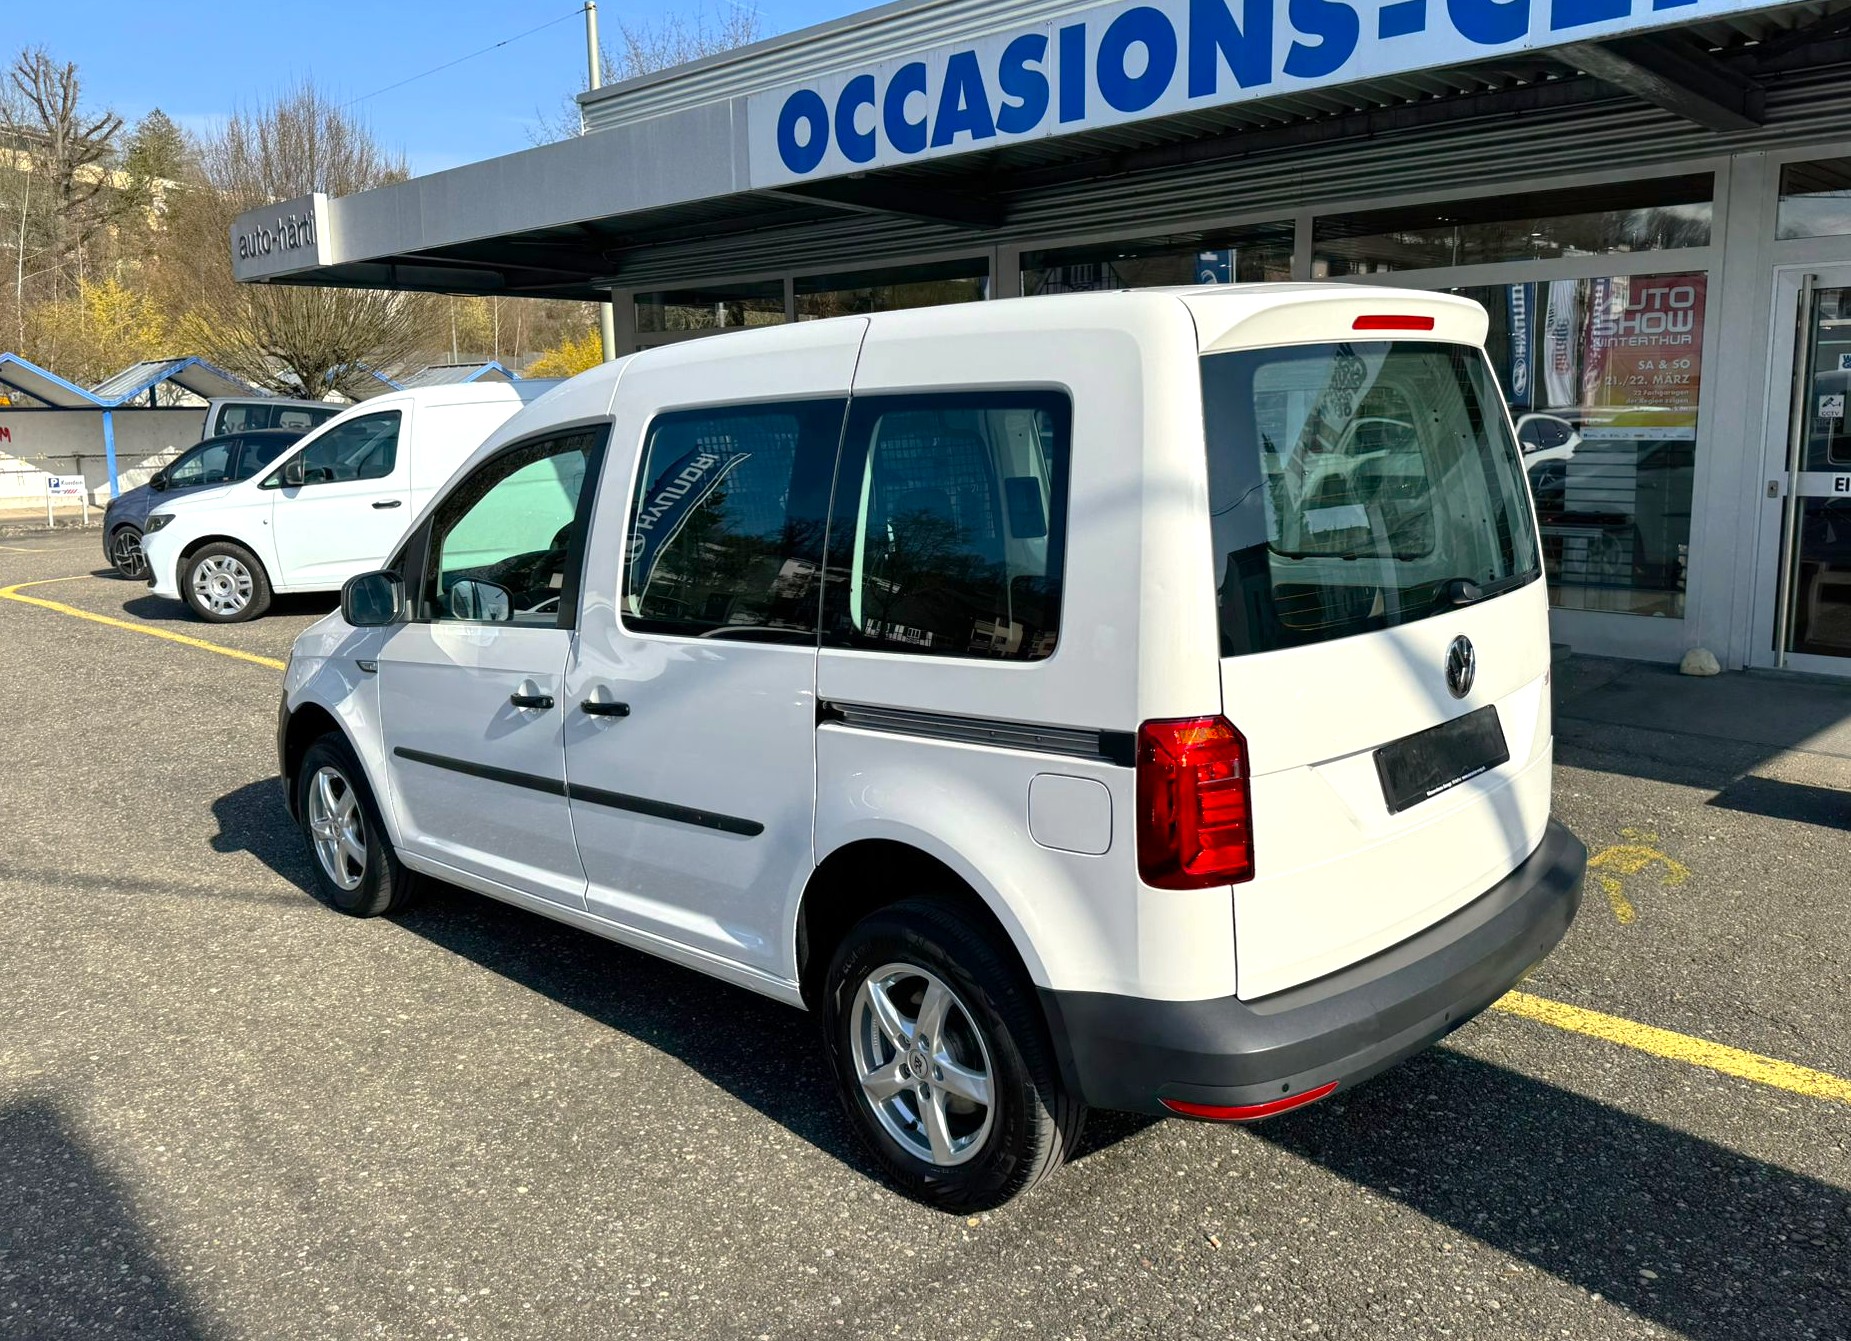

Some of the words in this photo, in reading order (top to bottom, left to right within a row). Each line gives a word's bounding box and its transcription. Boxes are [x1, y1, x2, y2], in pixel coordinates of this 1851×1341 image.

[777, 0, 1699, 174] OCCASIONS-
[239, 210, 316, 259] auto-härti
[1638, 360, 1654, 370] SA
[1659, 359, 1668, 369] &
[1673, 359, 1691, 369] SO
[1653, 372, 1690, 384] MÄRZ
